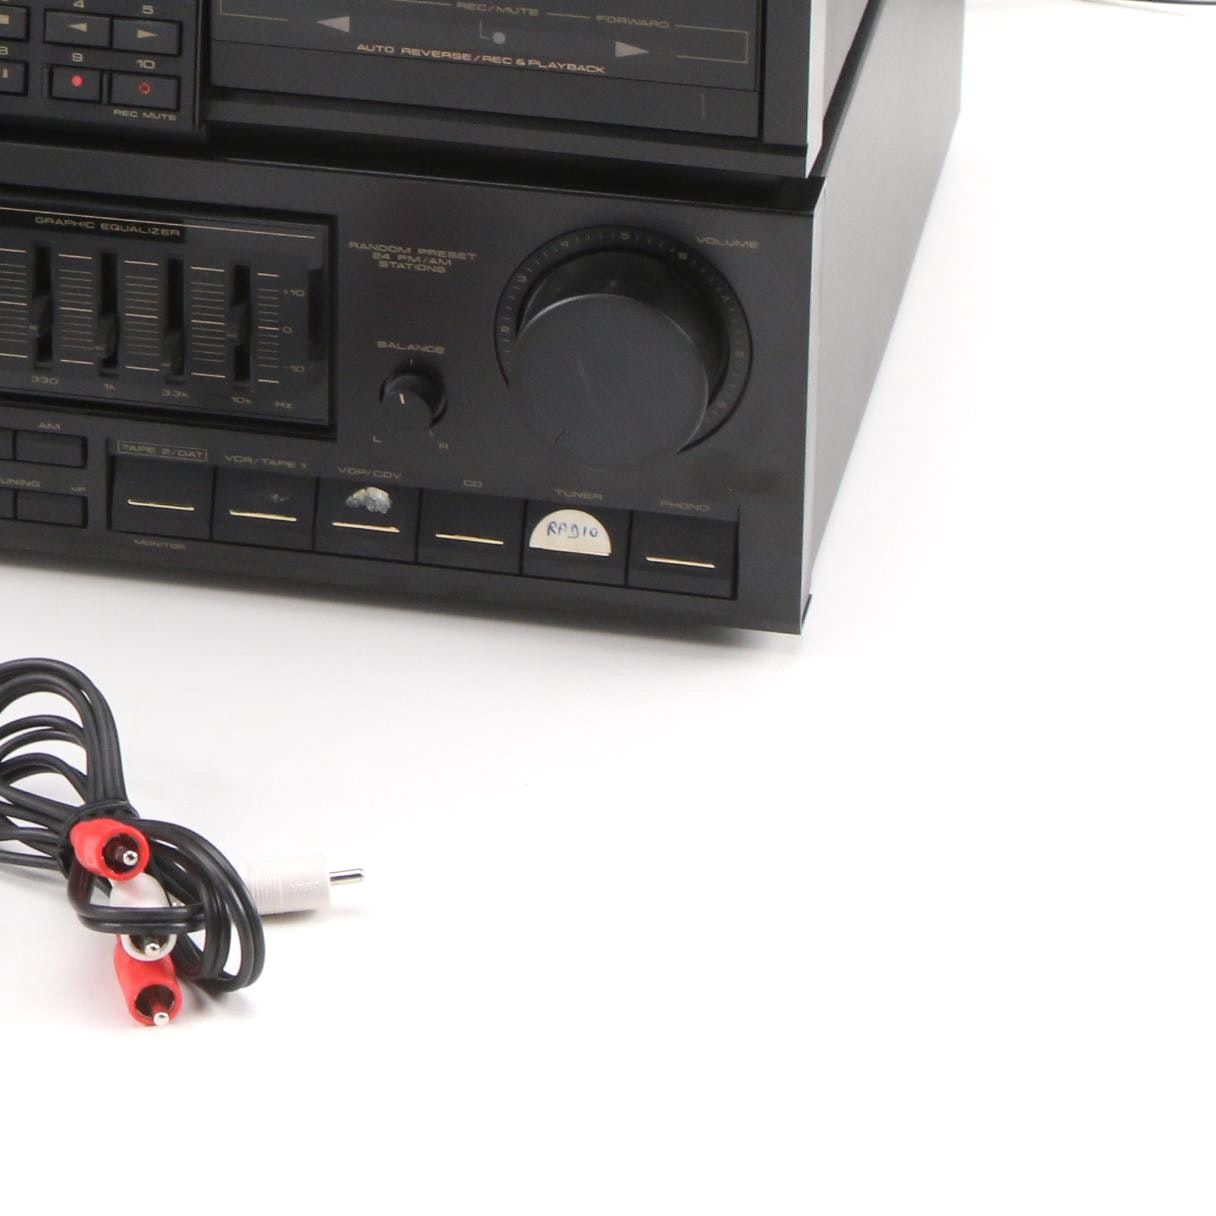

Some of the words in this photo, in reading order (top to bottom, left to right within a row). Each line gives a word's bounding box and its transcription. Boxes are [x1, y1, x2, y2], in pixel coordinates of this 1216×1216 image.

[72, 0, 84, 9] 4
[142, 4, 154, 16] 5
[456, 0, 539, 17] REC/MUTE
[596, 14, 670, 30] FORWARD
[72, 52, 84, 63] 9
[356, 42, 394, 54] AUTO
[400, 47, 514, 65] REVERSE/REC
[527, 58, 607, 74] PLAYBACK
[136, 60, 156, 70] 10
[112, 109, 138, 118] REC
[142, 112, 177, 122] MUTE
[34, 216, 96, 230] GRAPHIC
[100, 222, 181, 238] EQUALIZER
[696, 236, 760, 249] VOLUME
[348, 240, 412, 254] RANDOM
[417, 248, 478, 261] PRESET
[378, 260, 447, 274] STATIONS
[397, 254, 452, 267] FM/AM
[376, 340, 446, 354] BALANCE
[122, 444, 156, 456] TAPE
[160, 446, 204, 460] 2/DAT
[223, 454, 299, 469] VCR/TAPE
[463, 479, 483, 488] CD
[554, 488, 604, 501] TUNER
[659, 500, 710, 512] PHONO
[546, 520, 599, 540] RADIO
